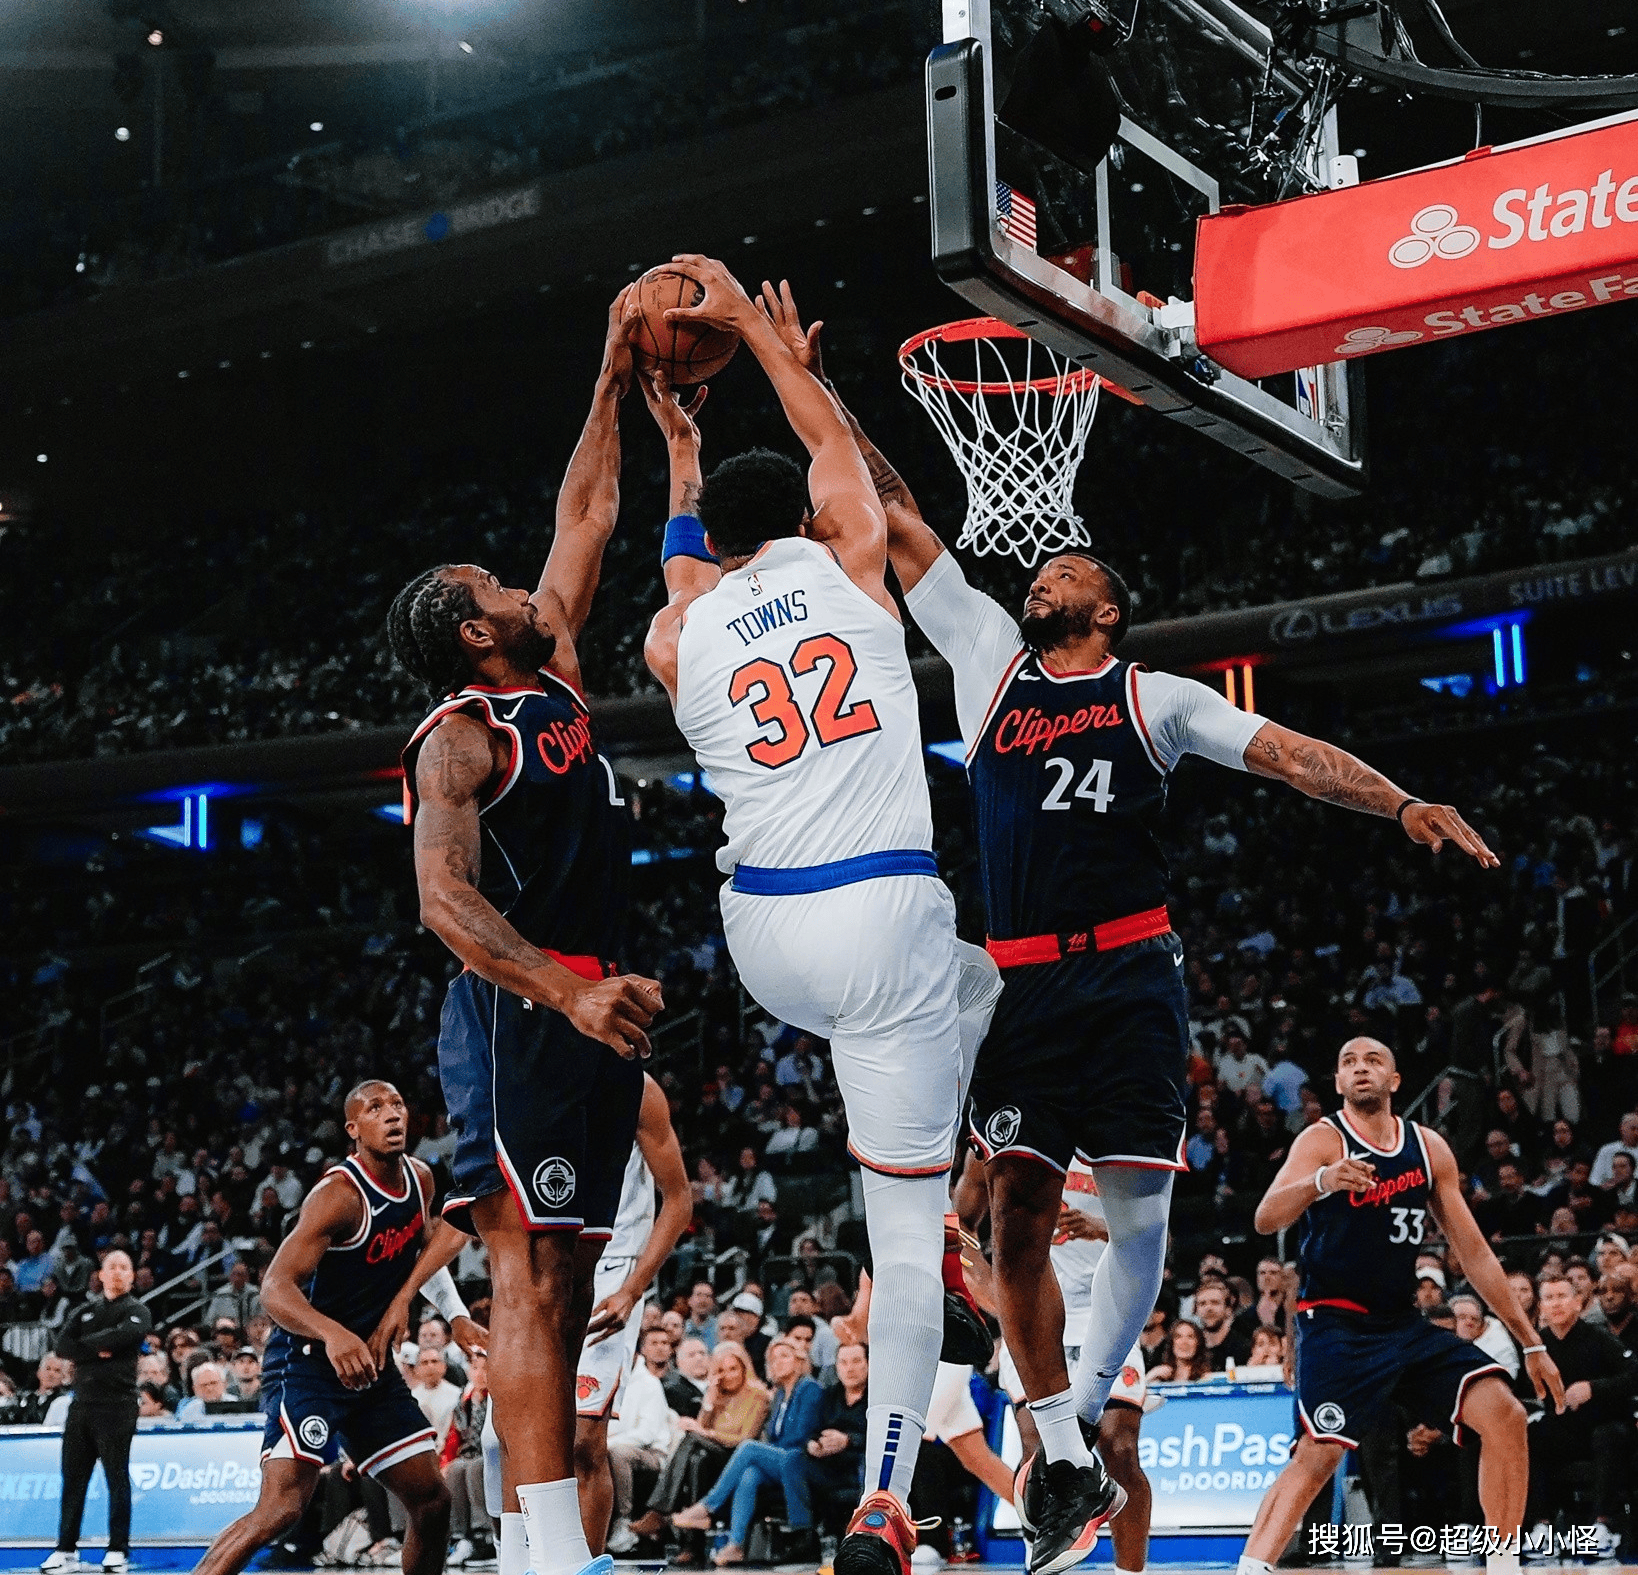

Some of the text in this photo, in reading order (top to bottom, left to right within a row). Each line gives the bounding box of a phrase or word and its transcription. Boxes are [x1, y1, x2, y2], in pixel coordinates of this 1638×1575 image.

[1487, 168, 1638, 250] State
[1424, 291, 1587, 335] State
[1321, 594, 1463, 632] LEXUS
[1509, 573, 1583, 605] SUITE
[726, 589, 808, 646] TOWNS
[728, 632, 882, 770] 32
[995, 703, 1124, 756] Clippers
[1041, 757, 1115, 813] 24
[1389, 1207, 1426, 1245] 33
[1160, 1476, 1178, 1494] by
